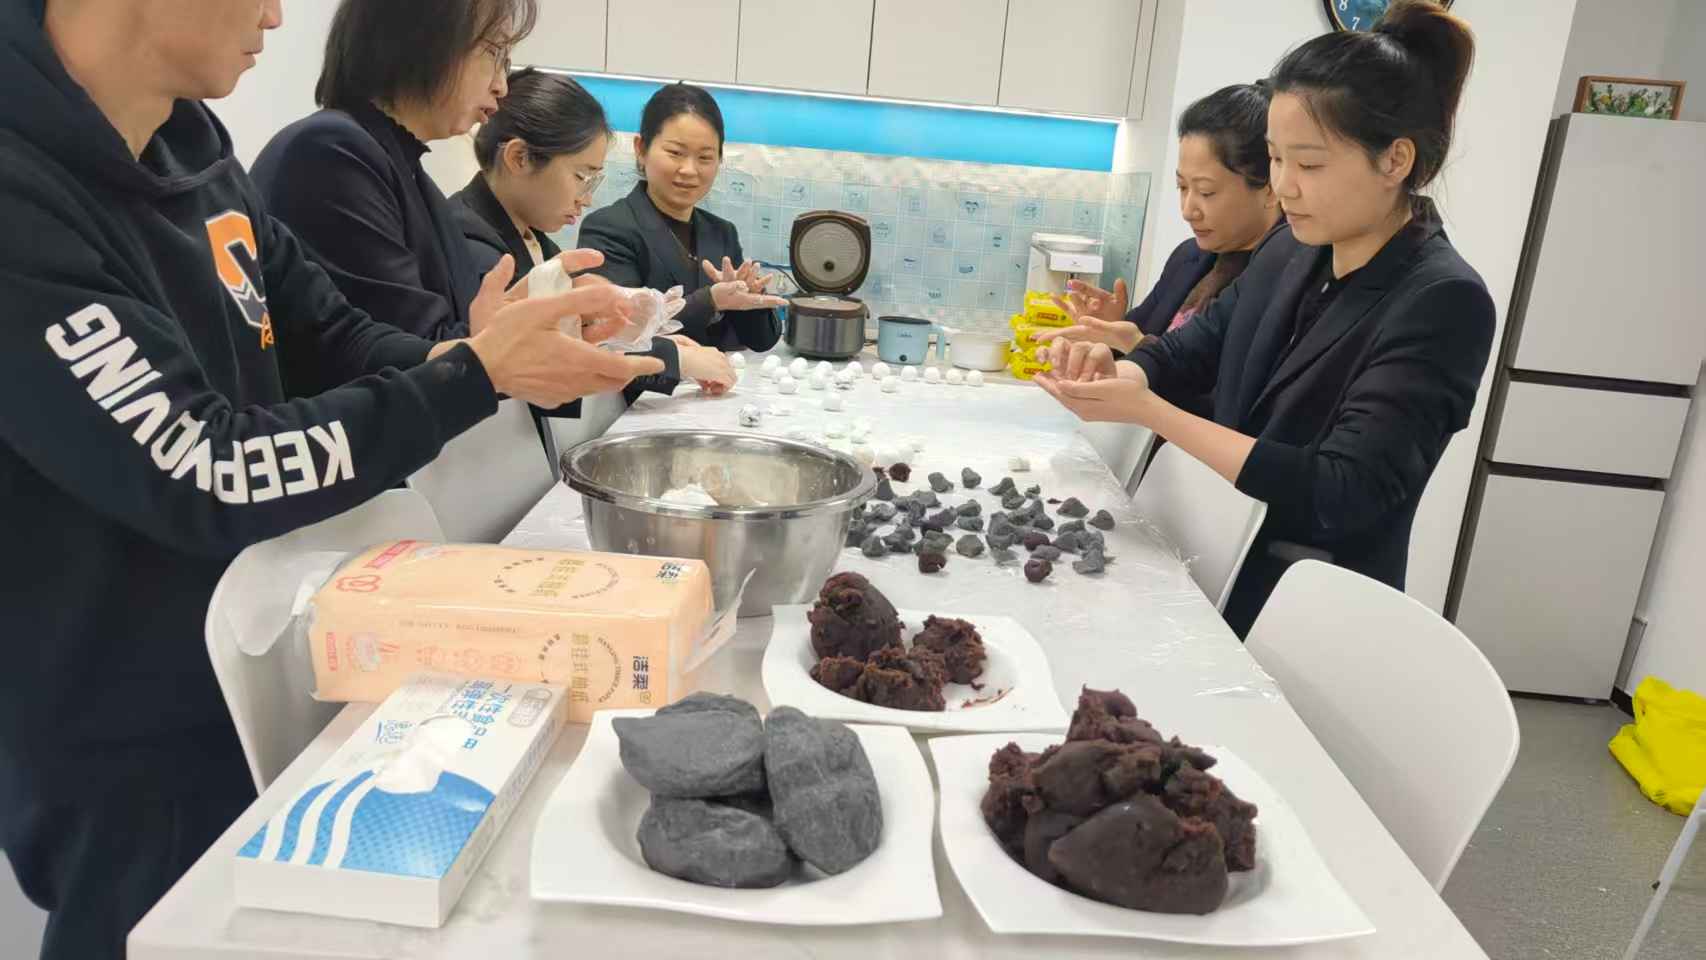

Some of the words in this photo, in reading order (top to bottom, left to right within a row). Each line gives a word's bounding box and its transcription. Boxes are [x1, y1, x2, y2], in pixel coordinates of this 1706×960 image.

[1339, 0, 1348, 11] 8
[1352, 17, 1360, 31] 7
[213, 420, 355, 504] KEEP
[632, 655, 649, 690] 洁柔
